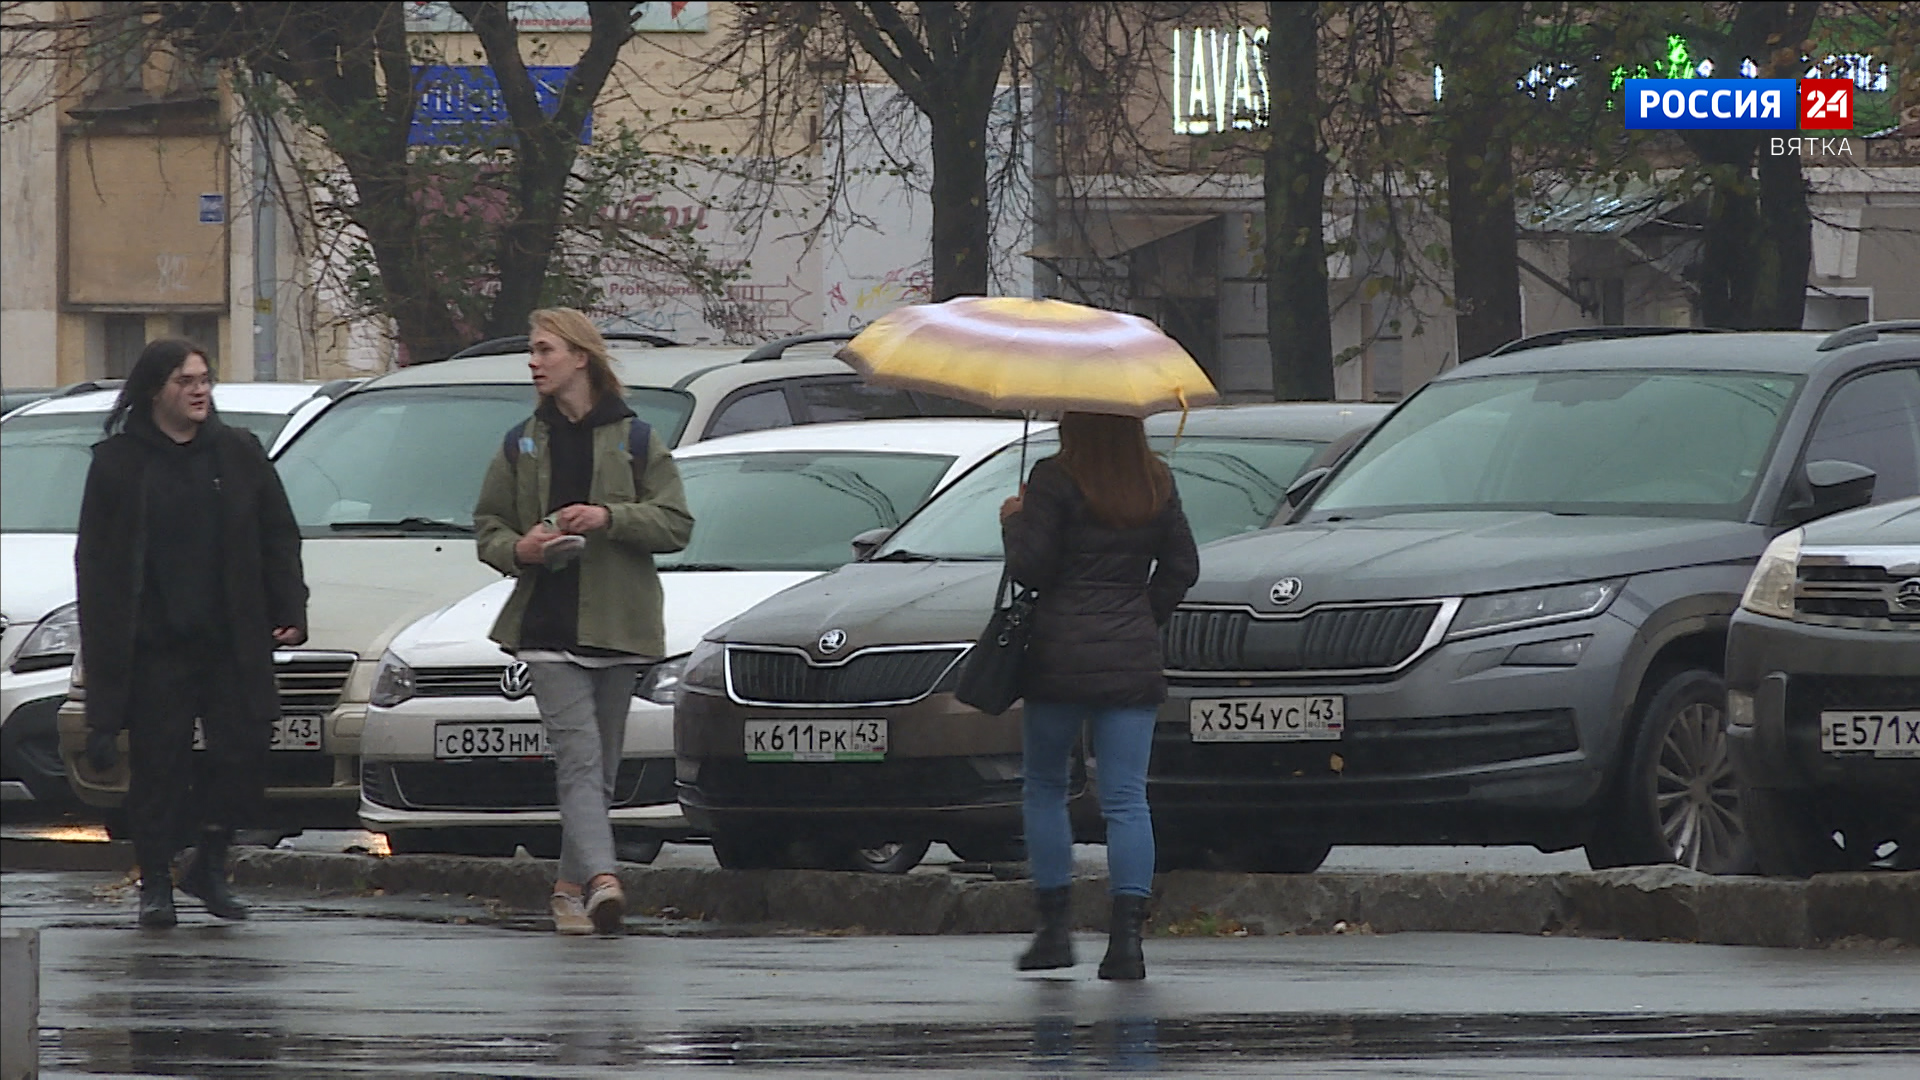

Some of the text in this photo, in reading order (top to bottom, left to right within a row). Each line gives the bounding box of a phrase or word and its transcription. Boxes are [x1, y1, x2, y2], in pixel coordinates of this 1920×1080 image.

[288, 719, 312, 738] 43
[1201, 699, 1335, 732] Х354УС 43
[445, 727, 540, 754] С833НМ
[754, 723, 879, 751] К611РК 43
